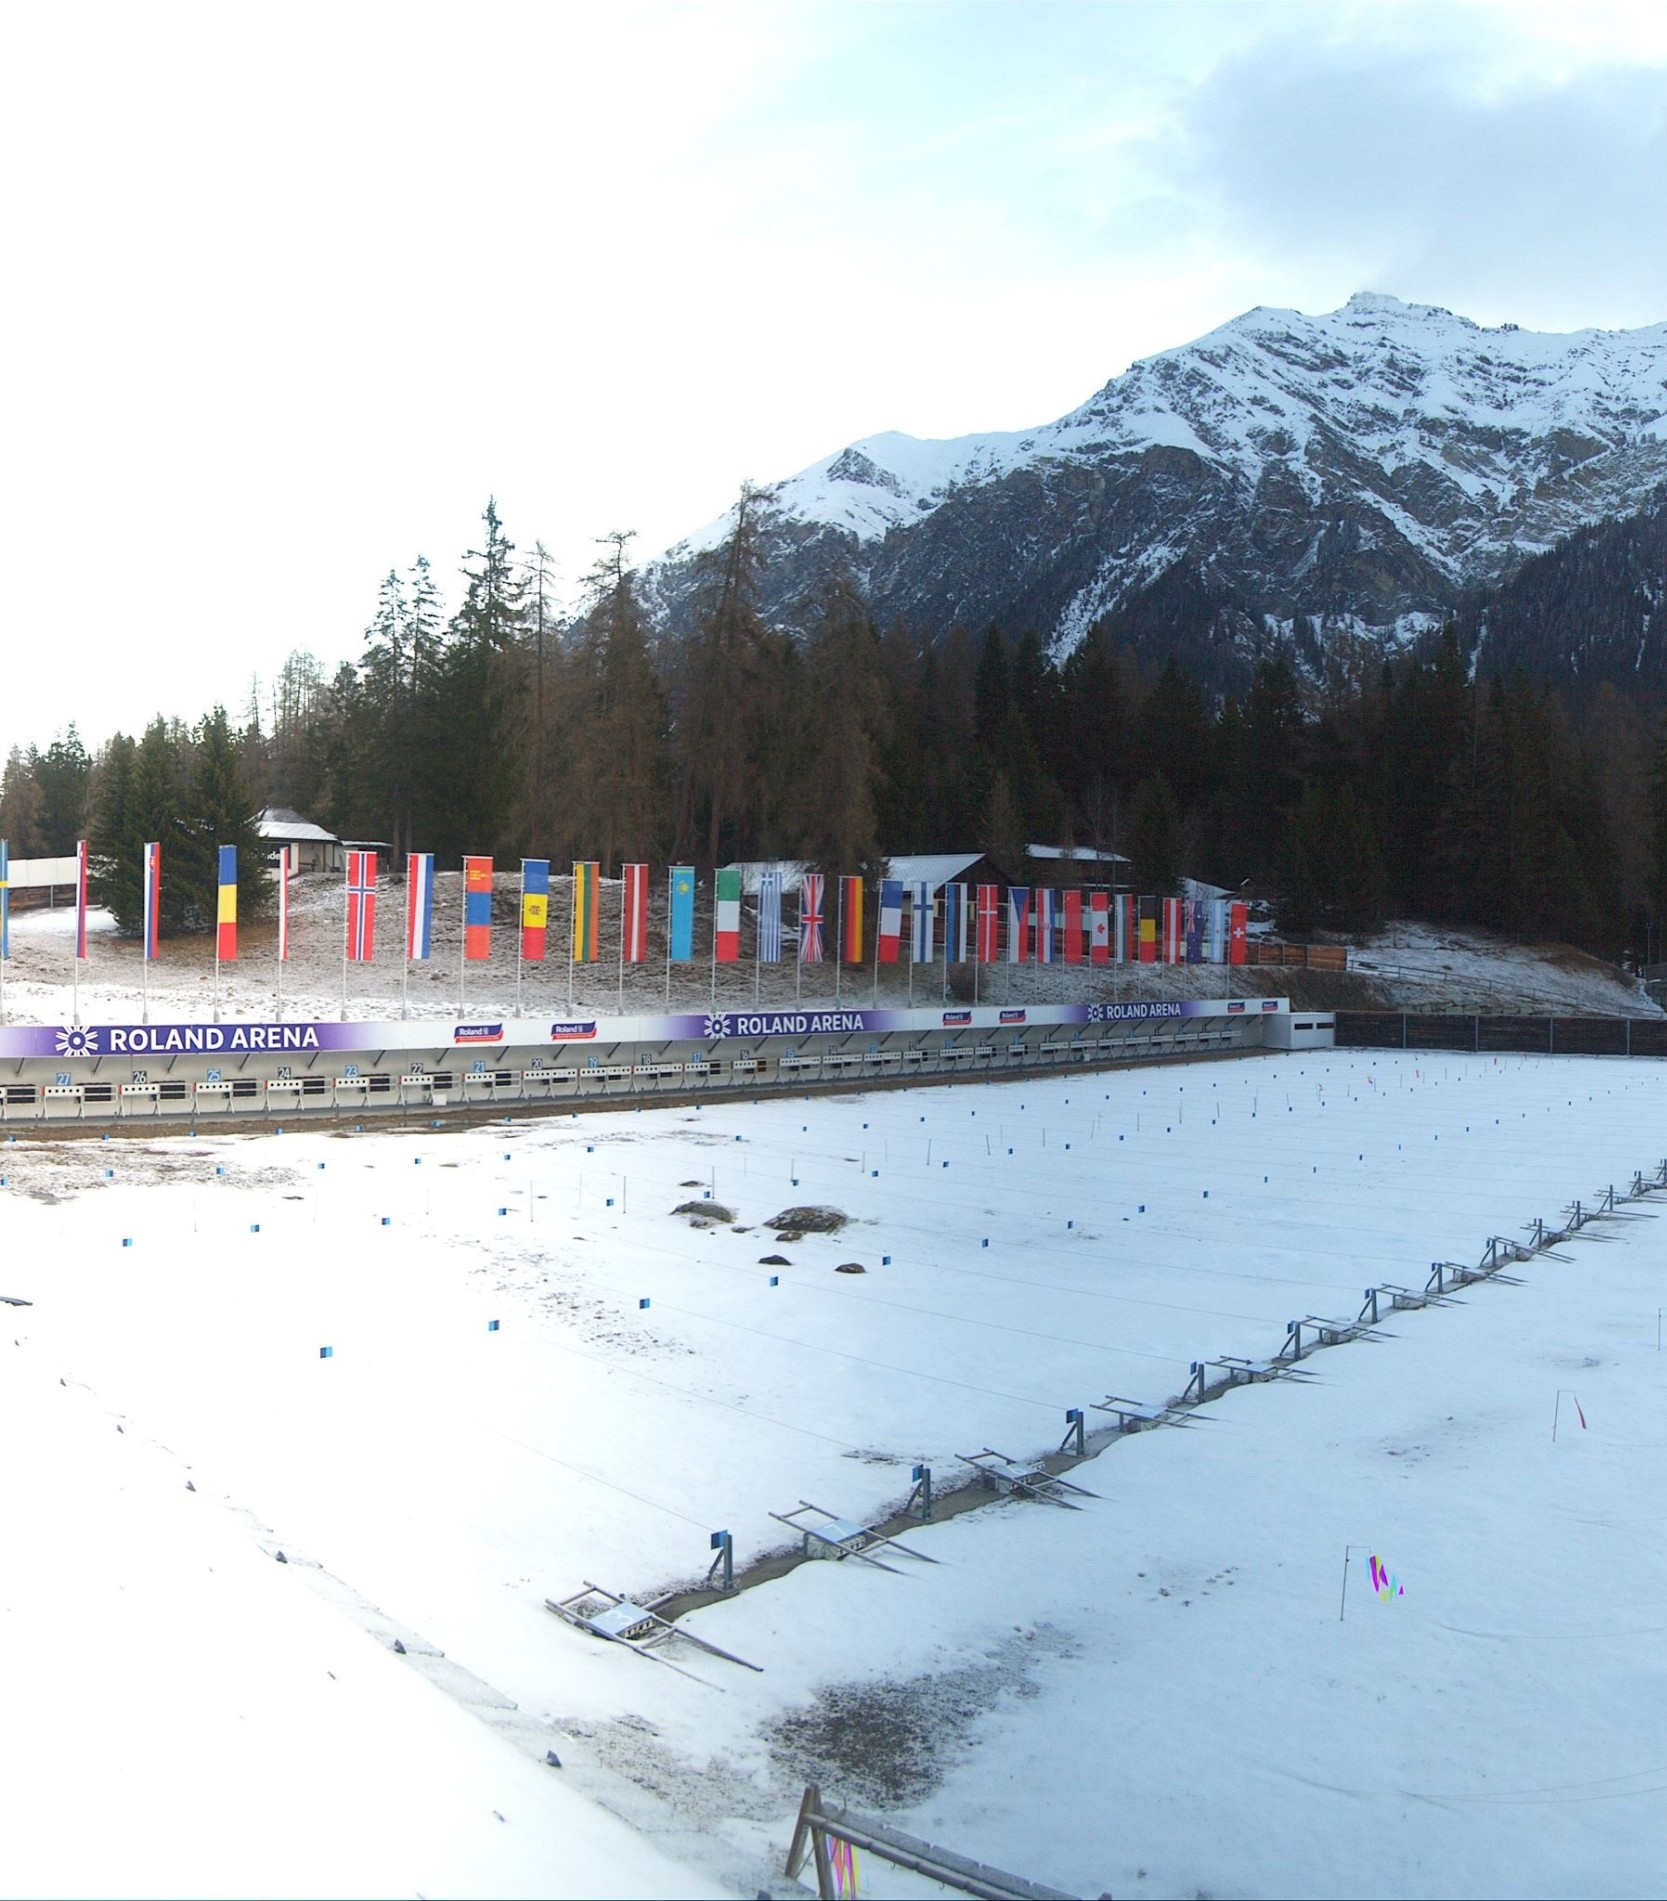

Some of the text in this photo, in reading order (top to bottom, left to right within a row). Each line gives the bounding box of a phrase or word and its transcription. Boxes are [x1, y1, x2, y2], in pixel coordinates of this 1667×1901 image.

[1106, 1002, 1181, 1020] ROLAND ARENA
[555, 1025, 578, 1034] Roland
[736, 1014, 864, 1035] ROLAND ARENA
[458, 1027, 483, 1036] Roland
[110, 1027, 320, 1051] ROLAND ARENA
[588, 1057, 599, 1068] 19
[642, 1055, 651, 1066] 18
[692, 1053, 701, 1063] 17
[412, 1063, 423, 1075] 22
[474, 1062, 485, 1073] 21
[532, 1059, 543, 1070] 20
[207, 1069, 220, 1081] 25
[279, 1067, 291, 1079] 24
[345, 1065, 358, 1077] 23
[57, 1073, 70, 1086] 27
[133, 1072, 147, 1084] 26
